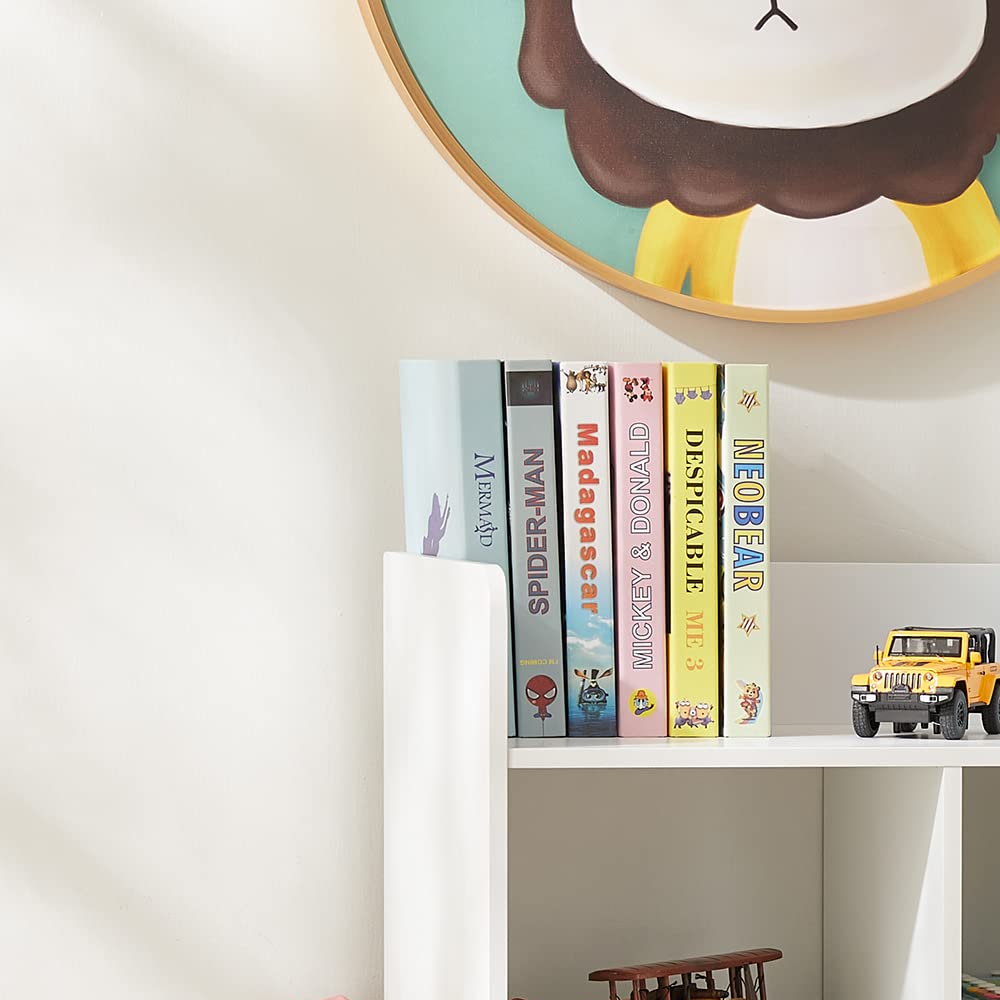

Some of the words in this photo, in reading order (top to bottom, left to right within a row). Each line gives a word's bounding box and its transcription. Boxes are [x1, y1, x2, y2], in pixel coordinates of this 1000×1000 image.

[524, 448, 550, 615] SPIDER-MAN
[574, 423, 599, 614] Madagascar
[629, 422, 651, 535] DONALD
[684, 428, 704, 593] DESPICABLE
[732, 438, 765, 592] NEOBEAR
[632, 541, 652, 560] &
[632, 568, 652, 670] MICKEY
[685, 612, 704, 649] ME
[685, 658, 704, 672] 3
